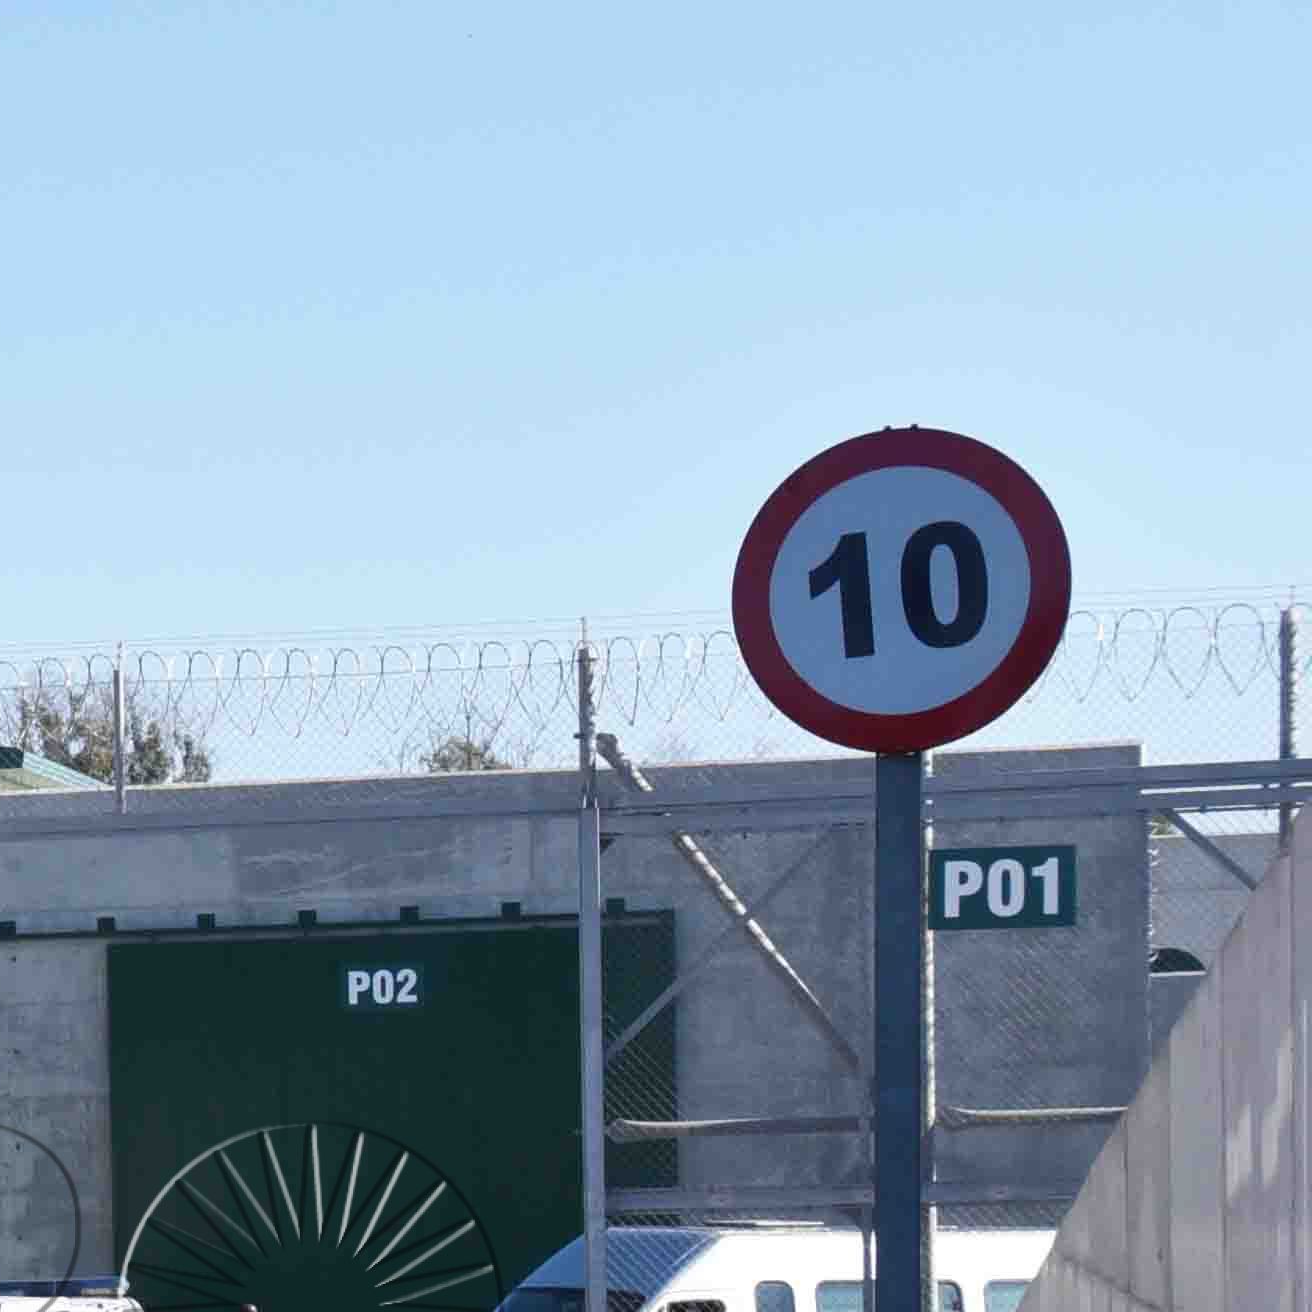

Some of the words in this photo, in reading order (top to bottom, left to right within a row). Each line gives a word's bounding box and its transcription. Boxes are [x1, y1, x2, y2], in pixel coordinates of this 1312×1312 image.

[808, 521, 988, 658] 10
[943, 857, 1059, 919] P01
[347, 968, 418, 1004] P02
